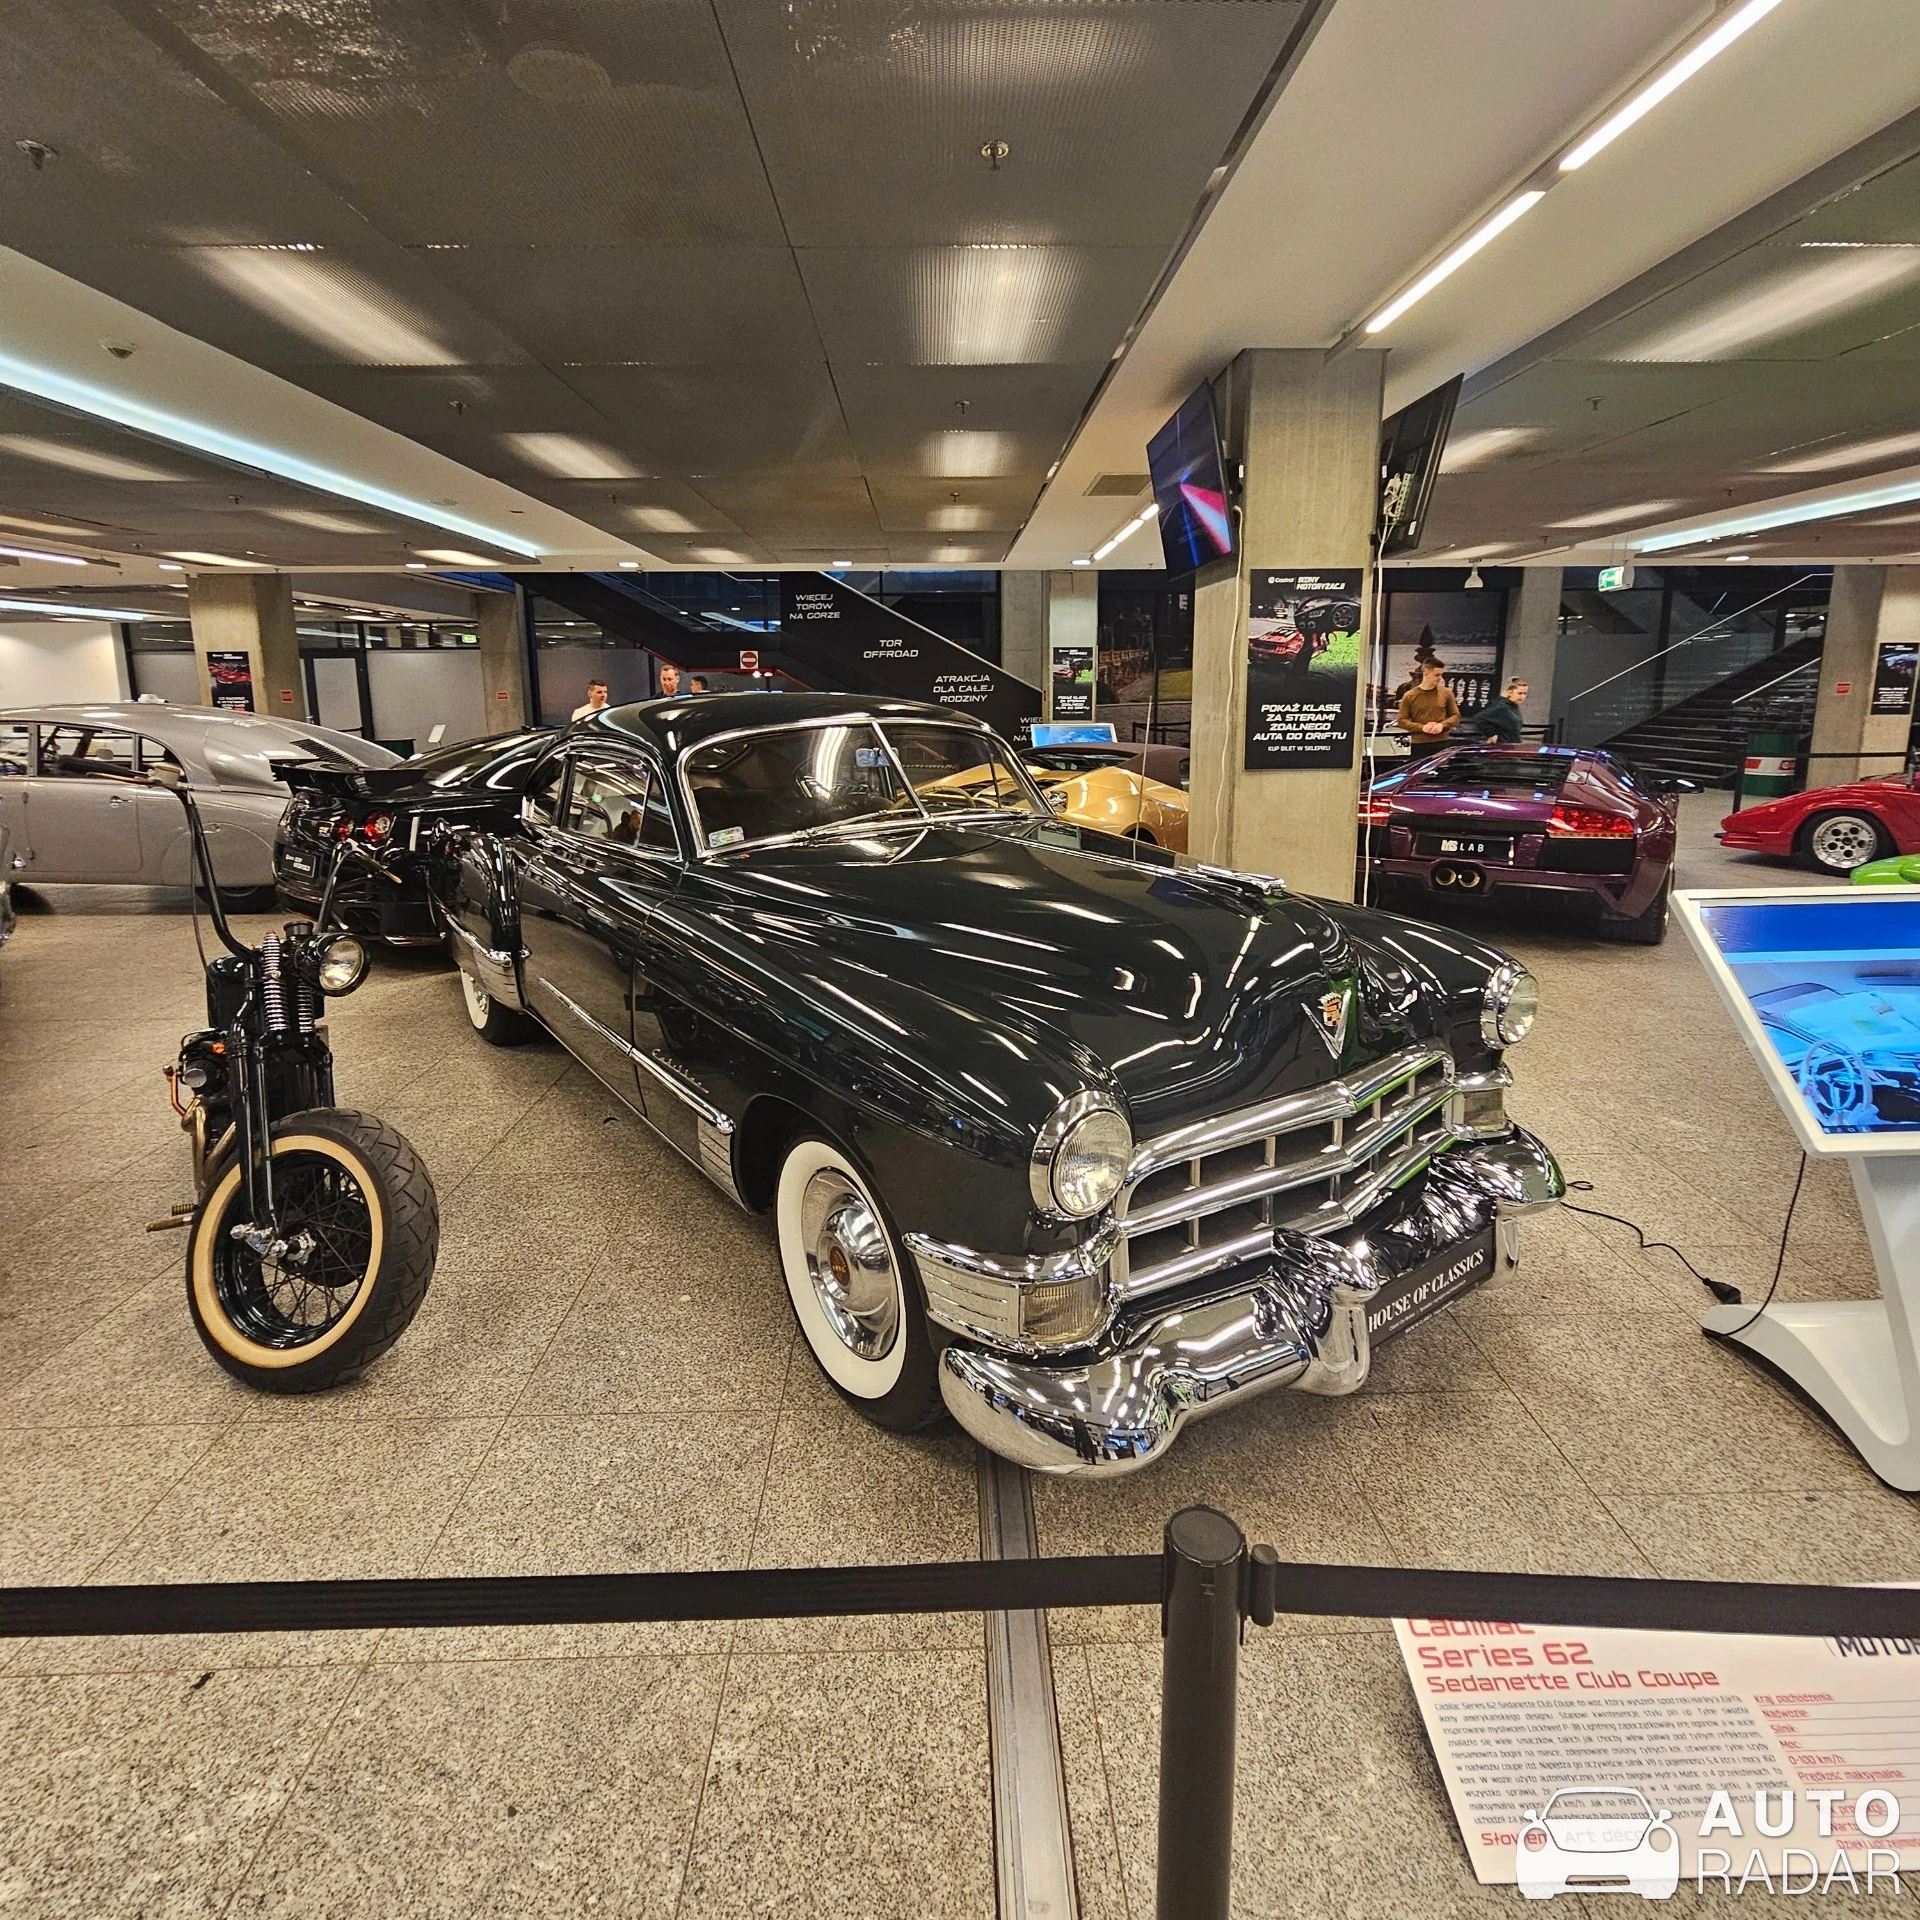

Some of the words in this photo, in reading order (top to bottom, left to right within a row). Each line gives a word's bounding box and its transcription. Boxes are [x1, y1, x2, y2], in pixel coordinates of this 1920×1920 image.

[796, 602, 834, 610] TORÓW
[806, 611, 841, 619] GÓRZE
[863, 650, 918, 658] OFFROAD
[935, 675, 990, 683] ATRAKCJA
[1261, 703, 1300, 712] POKAŻ
[1302, 704, 1341, 712] KLASĘ
[1285, 714, 1336, 722] STERAMI
[1253, 732, 1283, 740] AUTA
[1286, 732, 1302, 740] DO
[1305, 732, 1347, 740] DRIFTU
[1368, 1294, 1411, 1332] HOUSE
[1414, 1282, 1430, 1304] OF
[1432, 1248, 1484, 1292] CLASSICS
[1418, 1644, 1534, 1668] Series
[1542, 1642, 1594, 1666] 62
[1427, 1674, 1570, 1693] Sedanette
[1576, 1670, 1632, 1689] Club
[1637, 1670, 1720, 1690] Coupe
